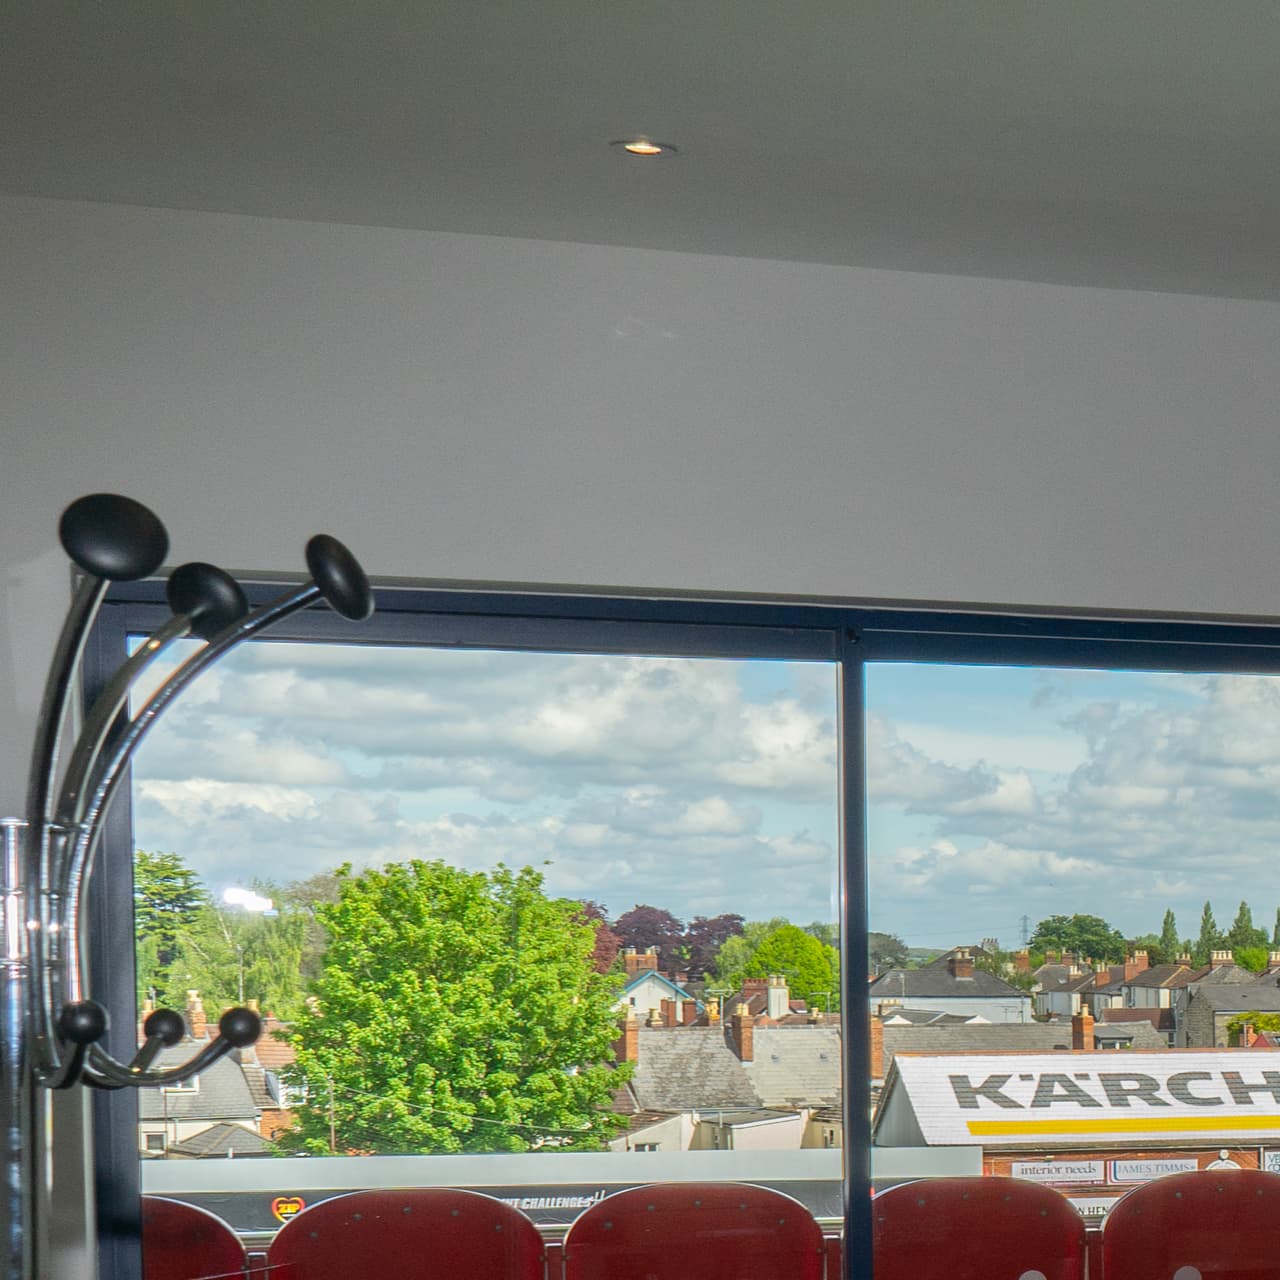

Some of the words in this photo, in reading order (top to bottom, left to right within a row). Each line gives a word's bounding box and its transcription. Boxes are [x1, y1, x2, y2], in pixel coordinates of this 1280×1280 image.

[1020, 1163, 1062, 1175] interior
[1065, 1161, 1097, 1174] needs
[1118, 1164, 1151, 1174] JAMES
